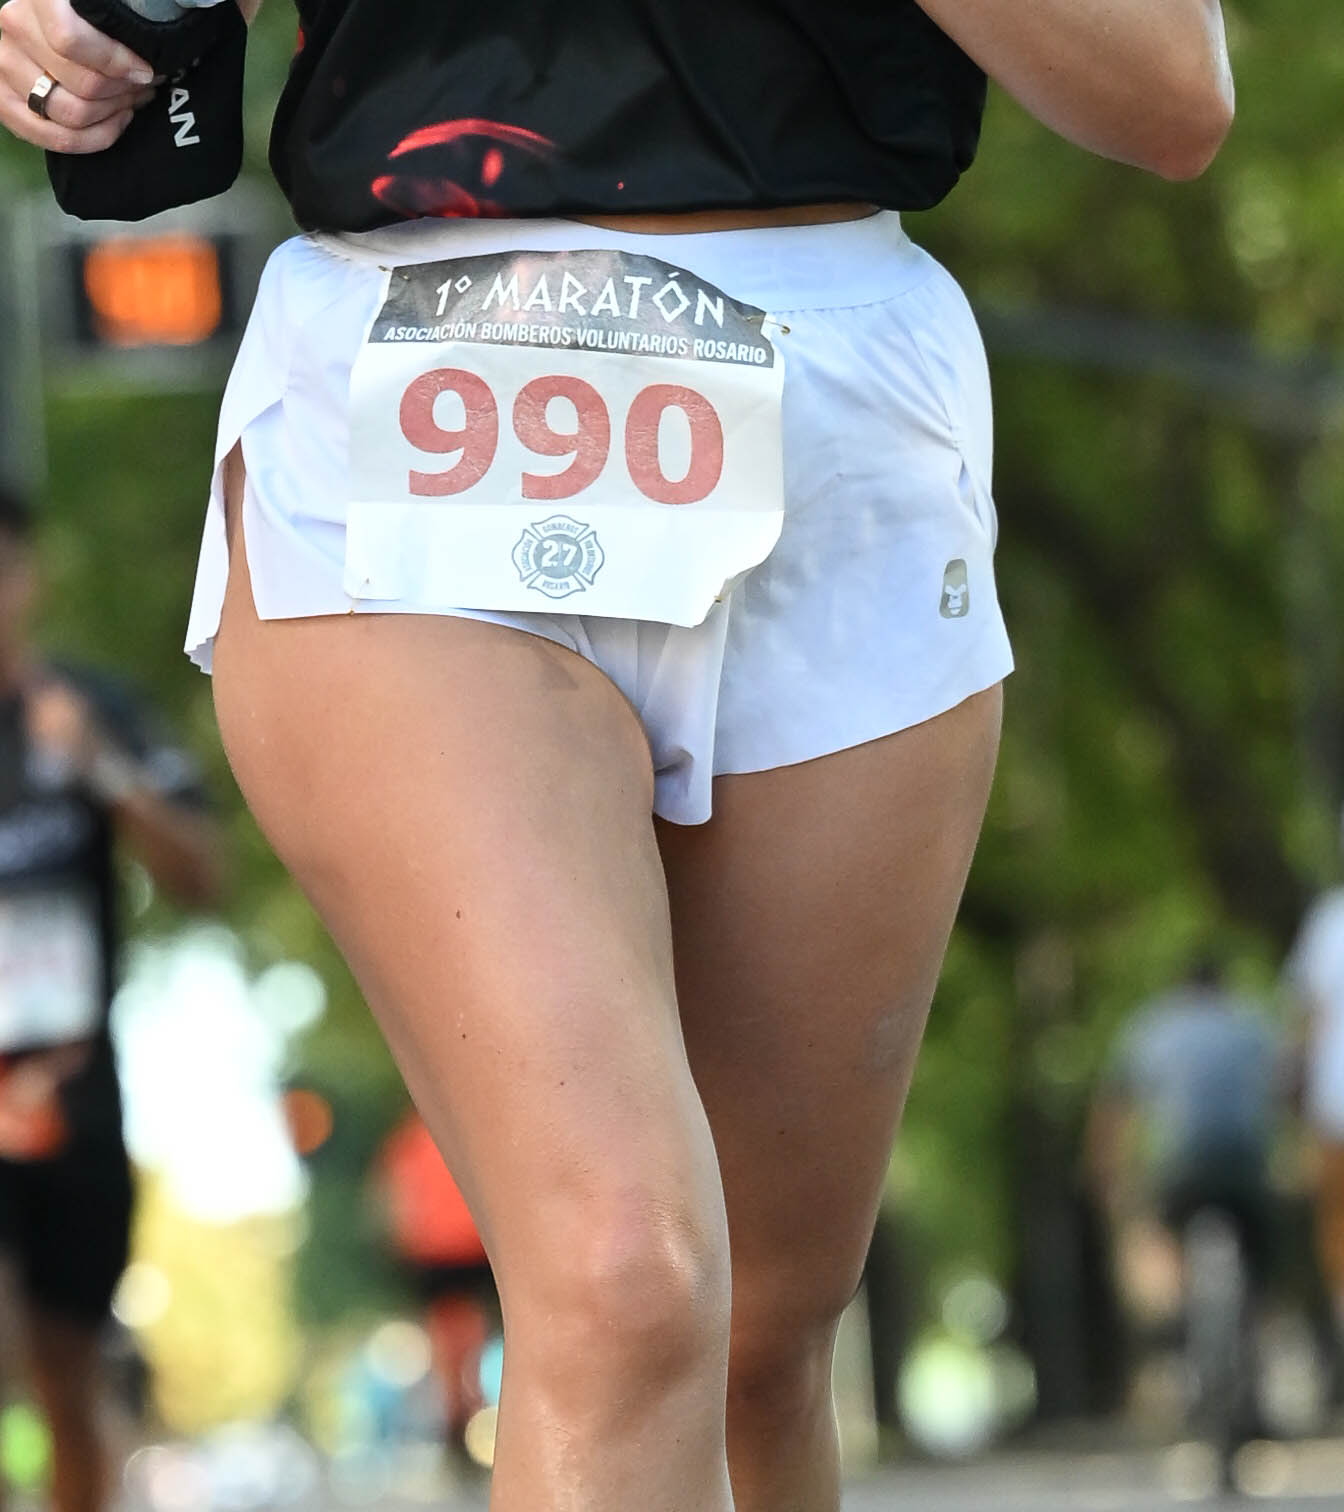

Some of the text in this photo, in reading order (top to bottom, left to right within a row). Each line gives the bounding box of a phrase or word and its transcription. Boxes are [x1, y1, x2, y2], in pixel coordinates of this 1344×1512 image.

[481, 271, 725, 329] MARATÓN
[383, 316, 768, 365] ASOCIACIÓN BOMBEROS VOLUNTARIOS ROSARIO
[398, 367, 725, 505] 990
[541, 539, 578, 568] 27
